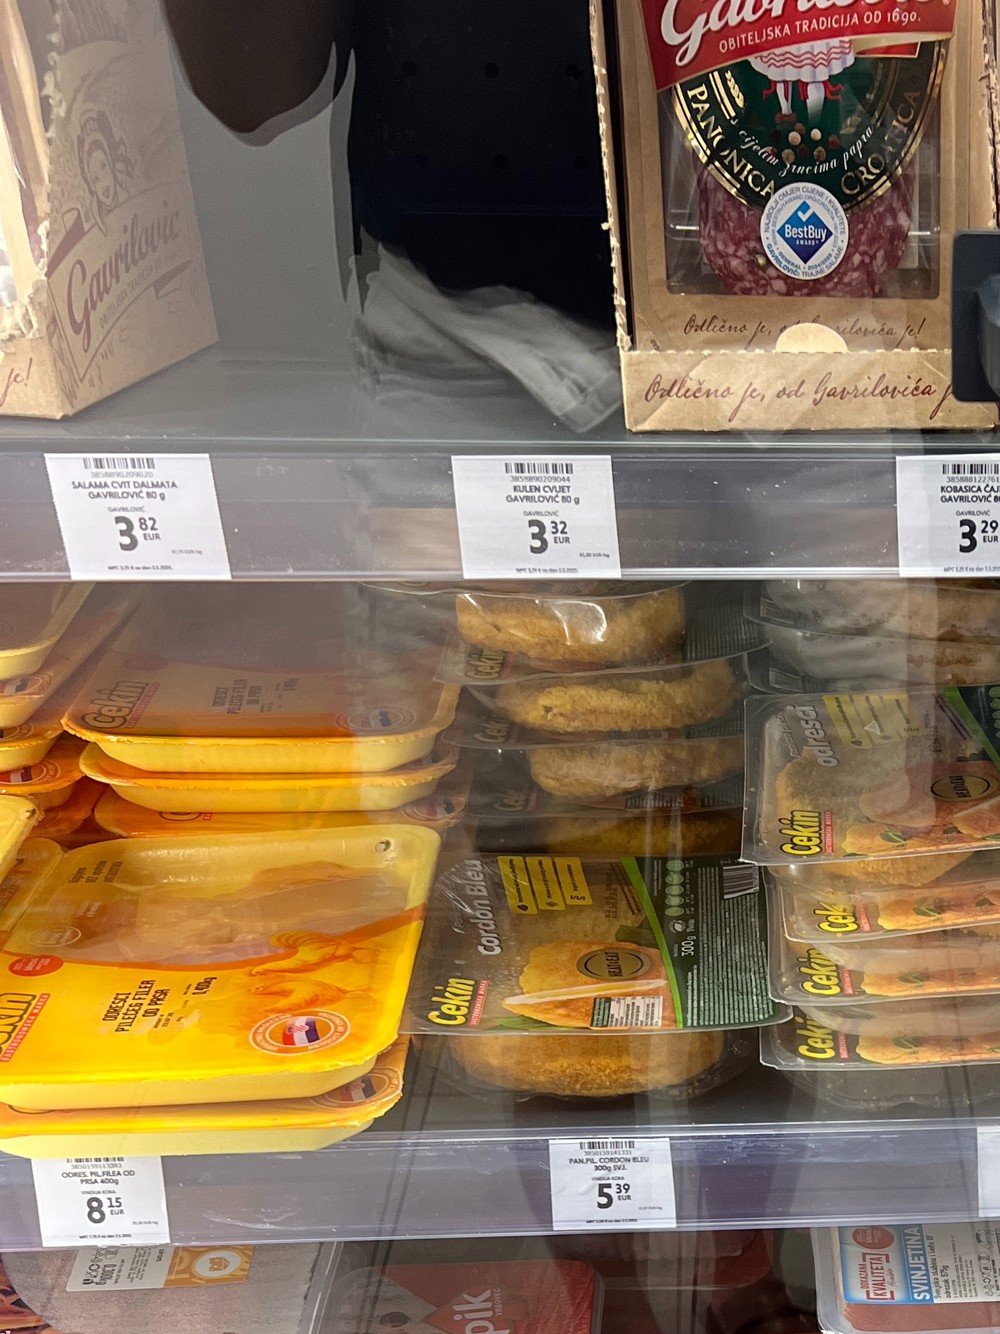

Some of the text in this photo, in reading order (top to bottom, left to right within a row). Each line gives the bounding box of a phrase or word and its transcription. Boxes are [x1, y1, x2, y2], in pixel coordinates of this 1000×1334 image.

[720, 9, 921, 53] OBITELJSKA TRADICIJA OD 1690.
[739, 130, 778, 166] cijelim
[842, 126, 873, 170] papra
[784, 224, 827, 242] BestBuy
[645, 374, 734, 401] Odlično
[776, 377, 805, 400] od
[812, 372, 936, 407] Gavrilovića
[72, 481, 178, 489] SALAMA CVIT DALMATA
[88, 490, 144, 499] GAVRILOVIĆ
[506, 494, 560, 503] GAVRILOVIĆ
[513, 485, 571, 493] KULEN CVIJET
[941, 485, 982, 493] KOBASICA
[941, 494, 992, 503] GAVRILOVIĆ
[115, 515, 158, 551] 3 82
[528, 519, 568, 554] 3 32
[959, 519, 999, 553] 3 29
[800, 705, 839, 768] odresci
[779, 809, 822, 856] Cekin
[465, 859, 482, 897] Bleu
[681, 936, 697, 957] 300g
[101, 991, 132, 1022] ODRESCI
[427, 977, 475, 1026] Cekin
[87, 1197, 122, 1224] 8 15
[597, 1183, 630, 1209] 5 39
[872, 1255, 887, 1298] KVALITETA
[904, 1226, 930, 1301] SVINJETINA
